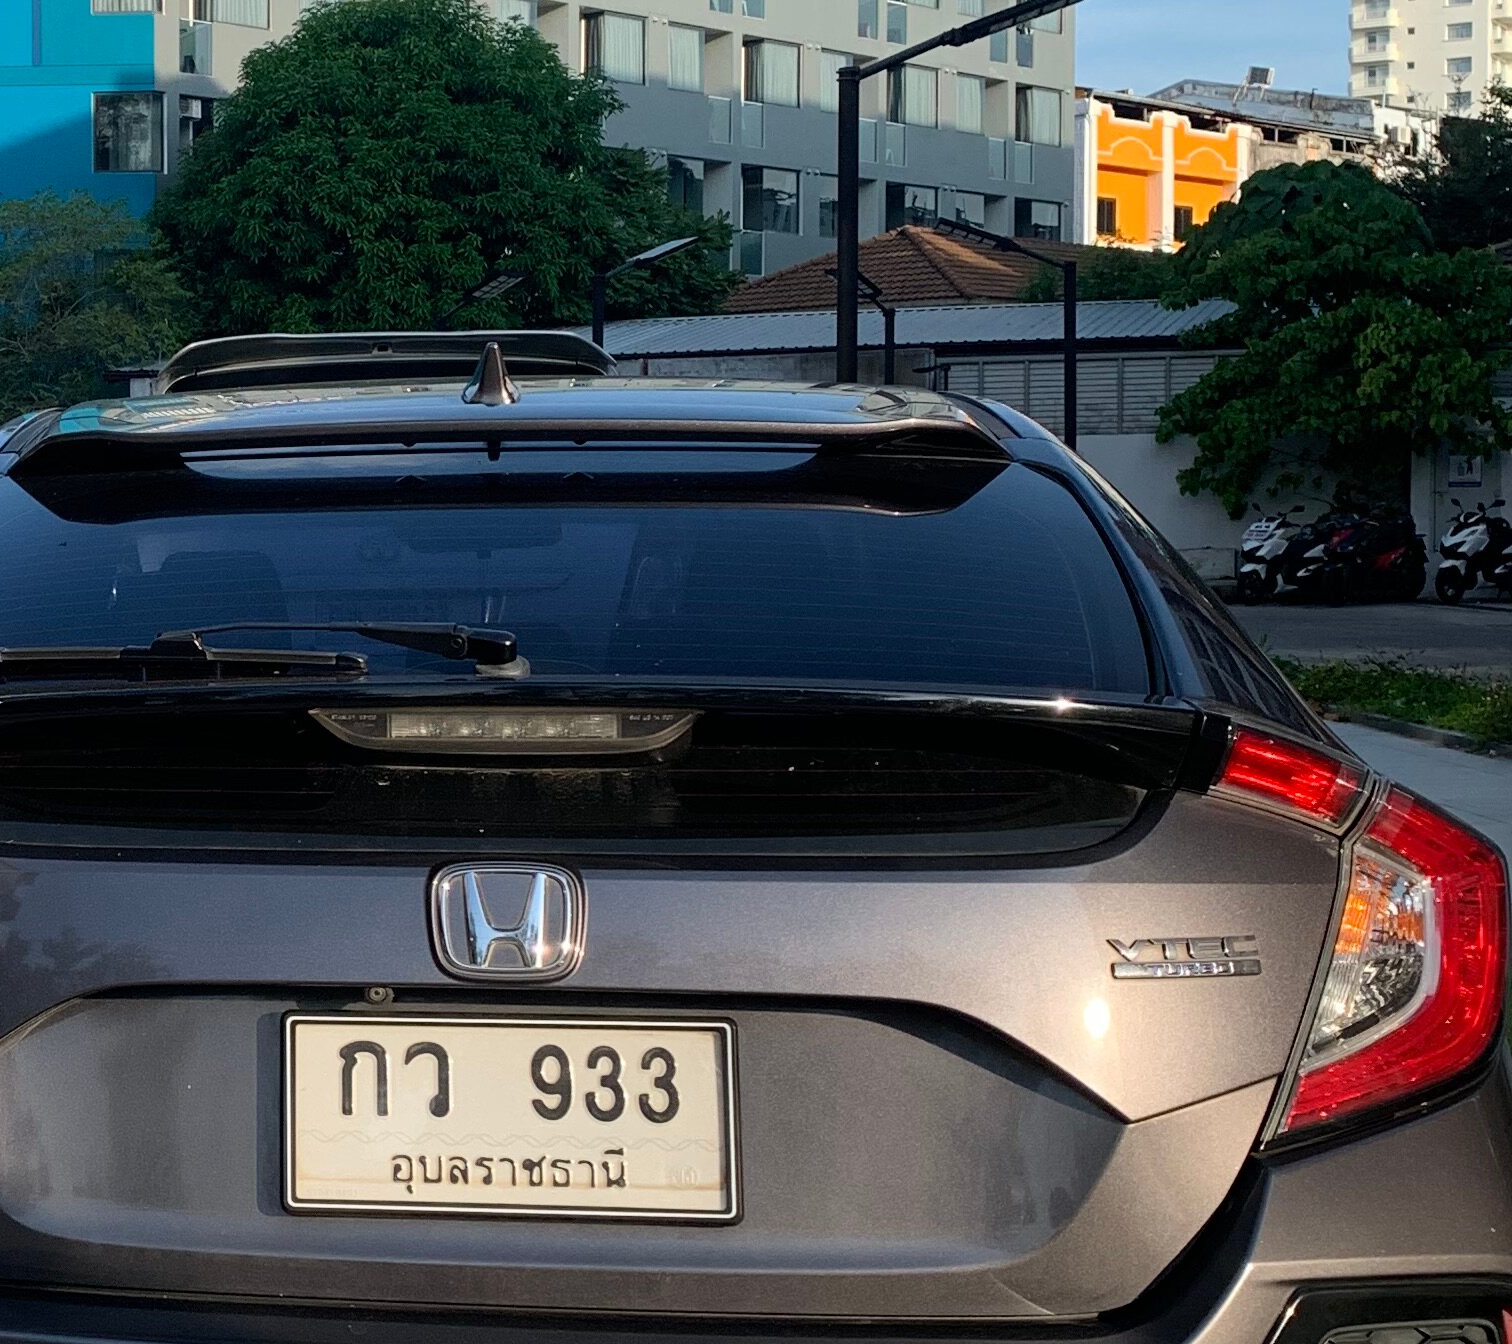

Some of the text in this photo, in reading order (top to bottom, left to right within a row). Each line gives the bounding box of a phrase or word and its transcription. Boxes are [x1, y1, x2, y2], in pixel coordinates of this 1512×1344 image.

[1106, 934, 1259, 961] VTEC
[1147, 961, 1235, 977] TURBO
[339, 1040, 680, 1124] กว 933
[391, 1147, 627, 1194] อุบลราชธานี
